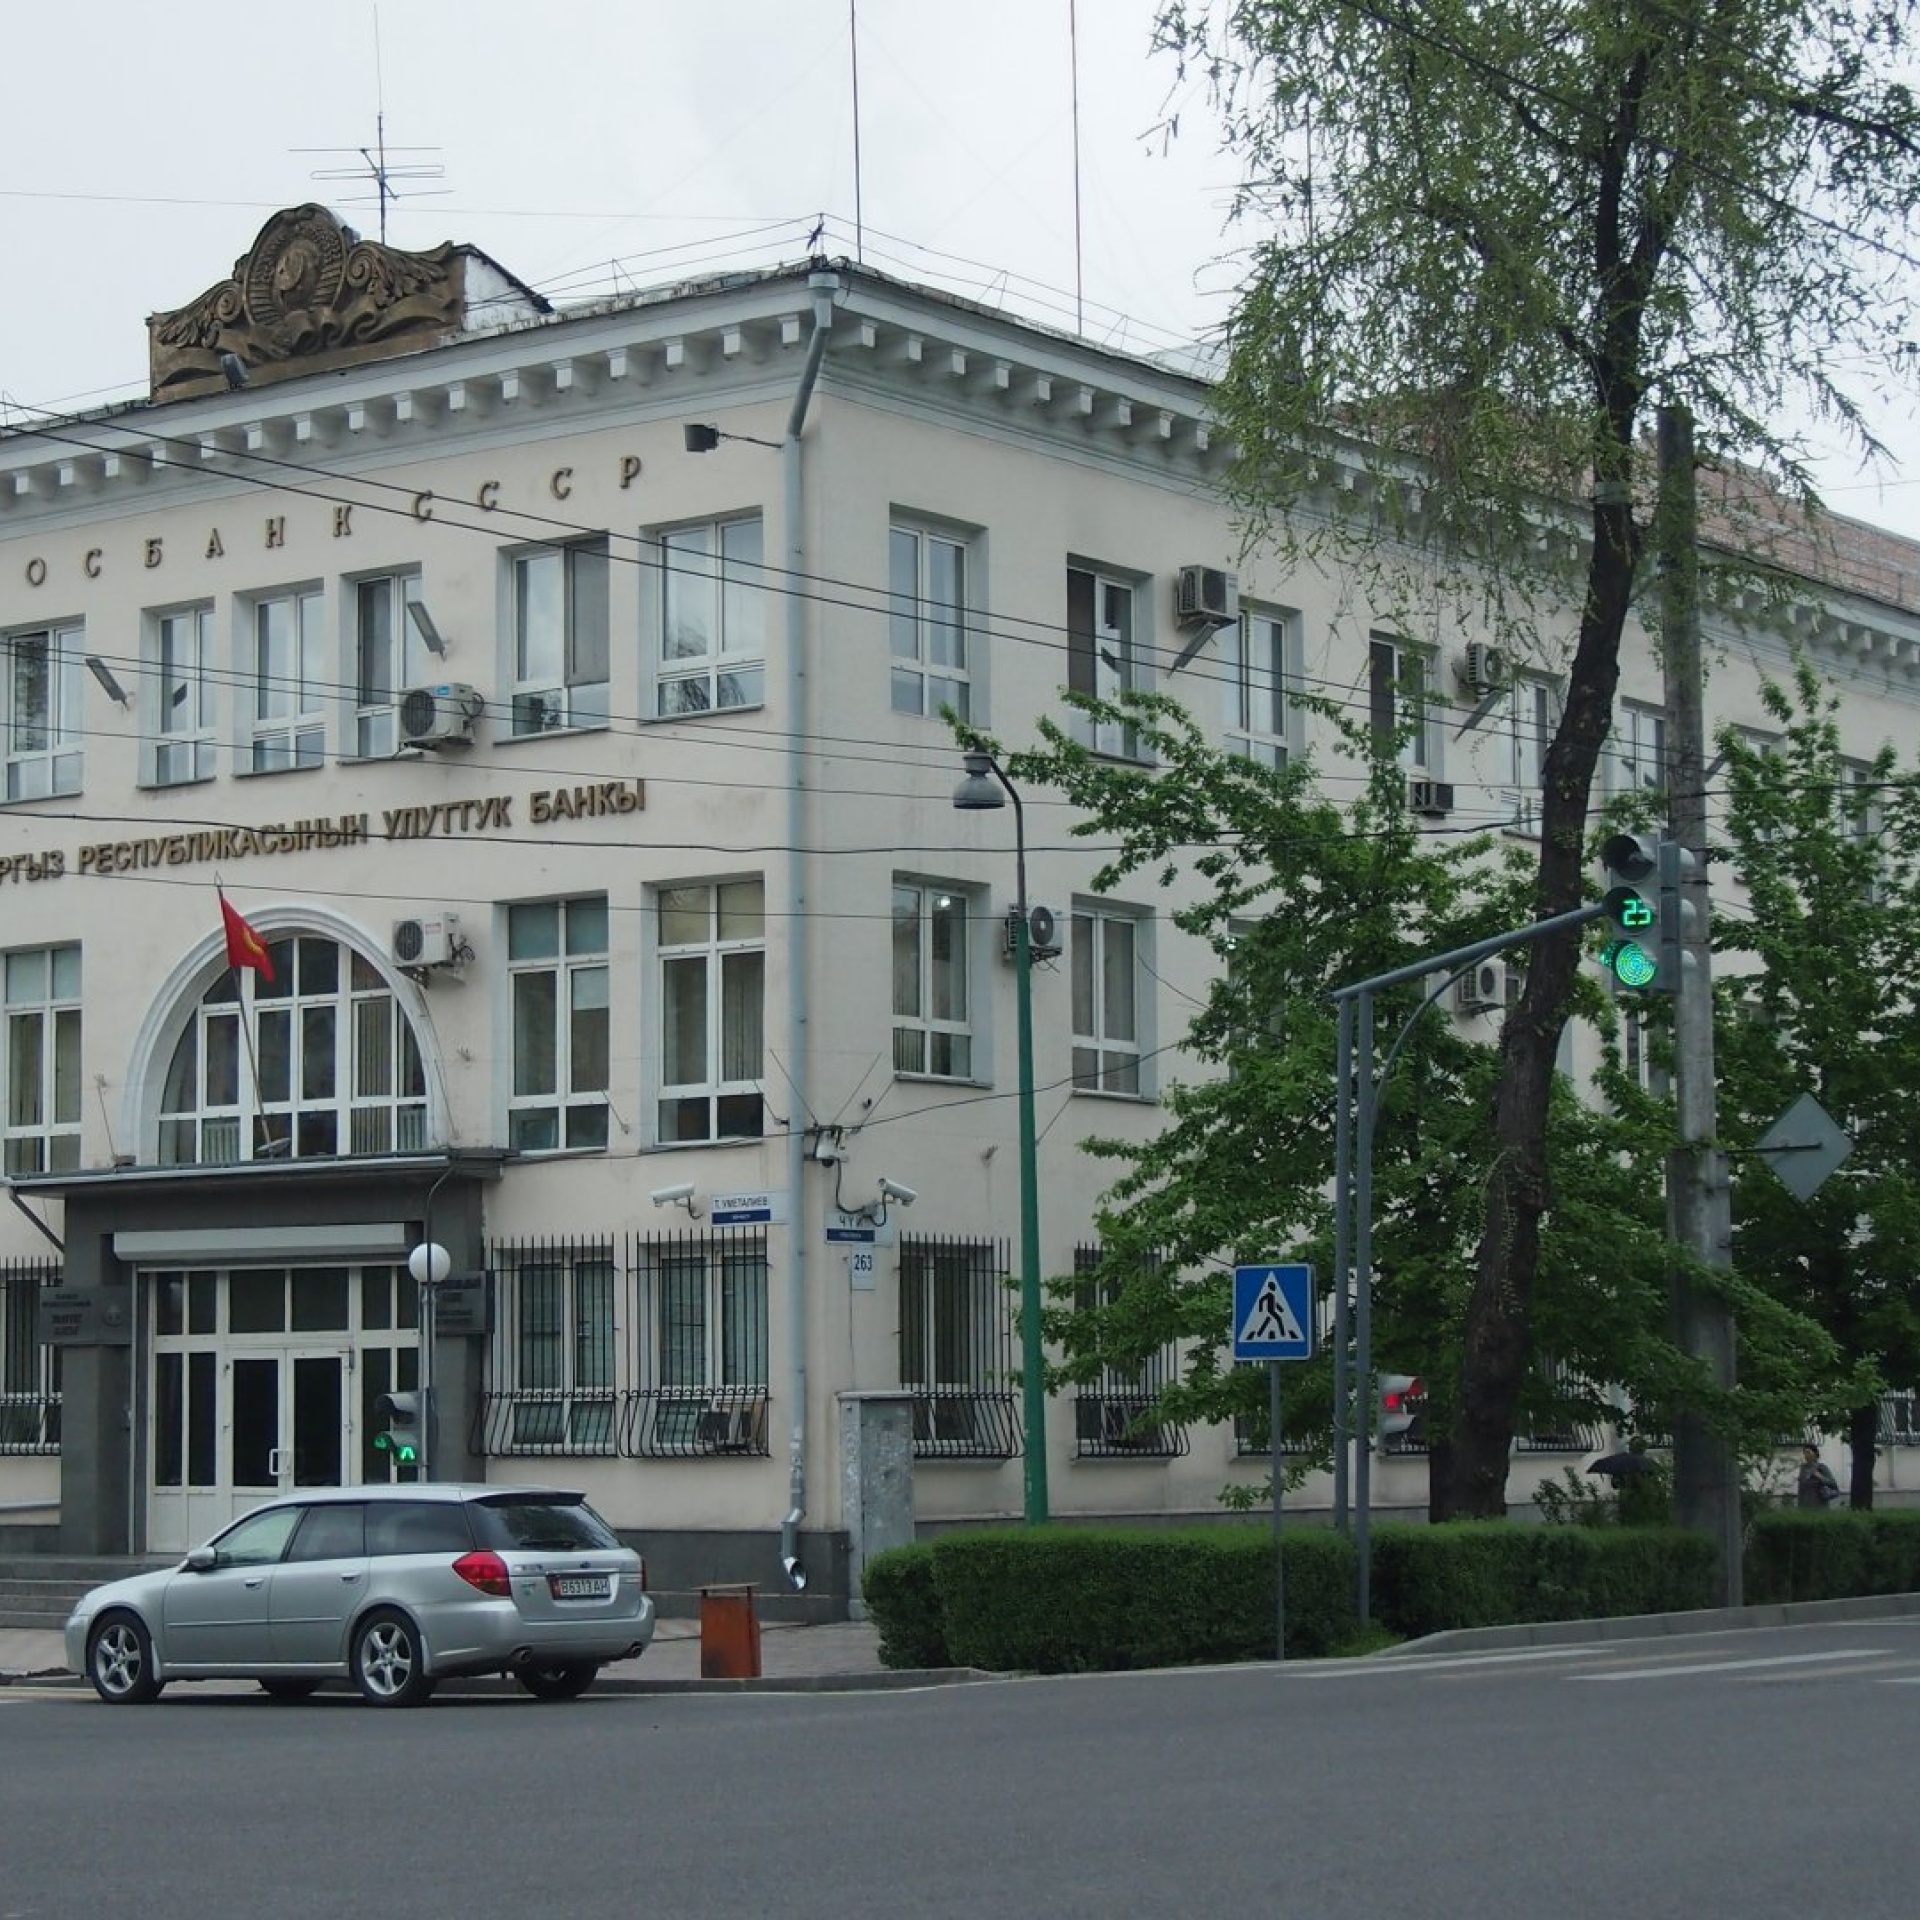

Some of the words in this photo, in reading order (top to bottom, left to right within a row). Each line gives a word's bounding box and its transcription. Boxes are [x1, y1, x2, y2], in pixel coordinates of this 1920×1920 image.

[78, 813, 368, 875] РЕСПУБЛИКАСЫНЫН
[530, 778, 646, 823] БАНКЫ
[853, 1254, 872, 1271] 263
